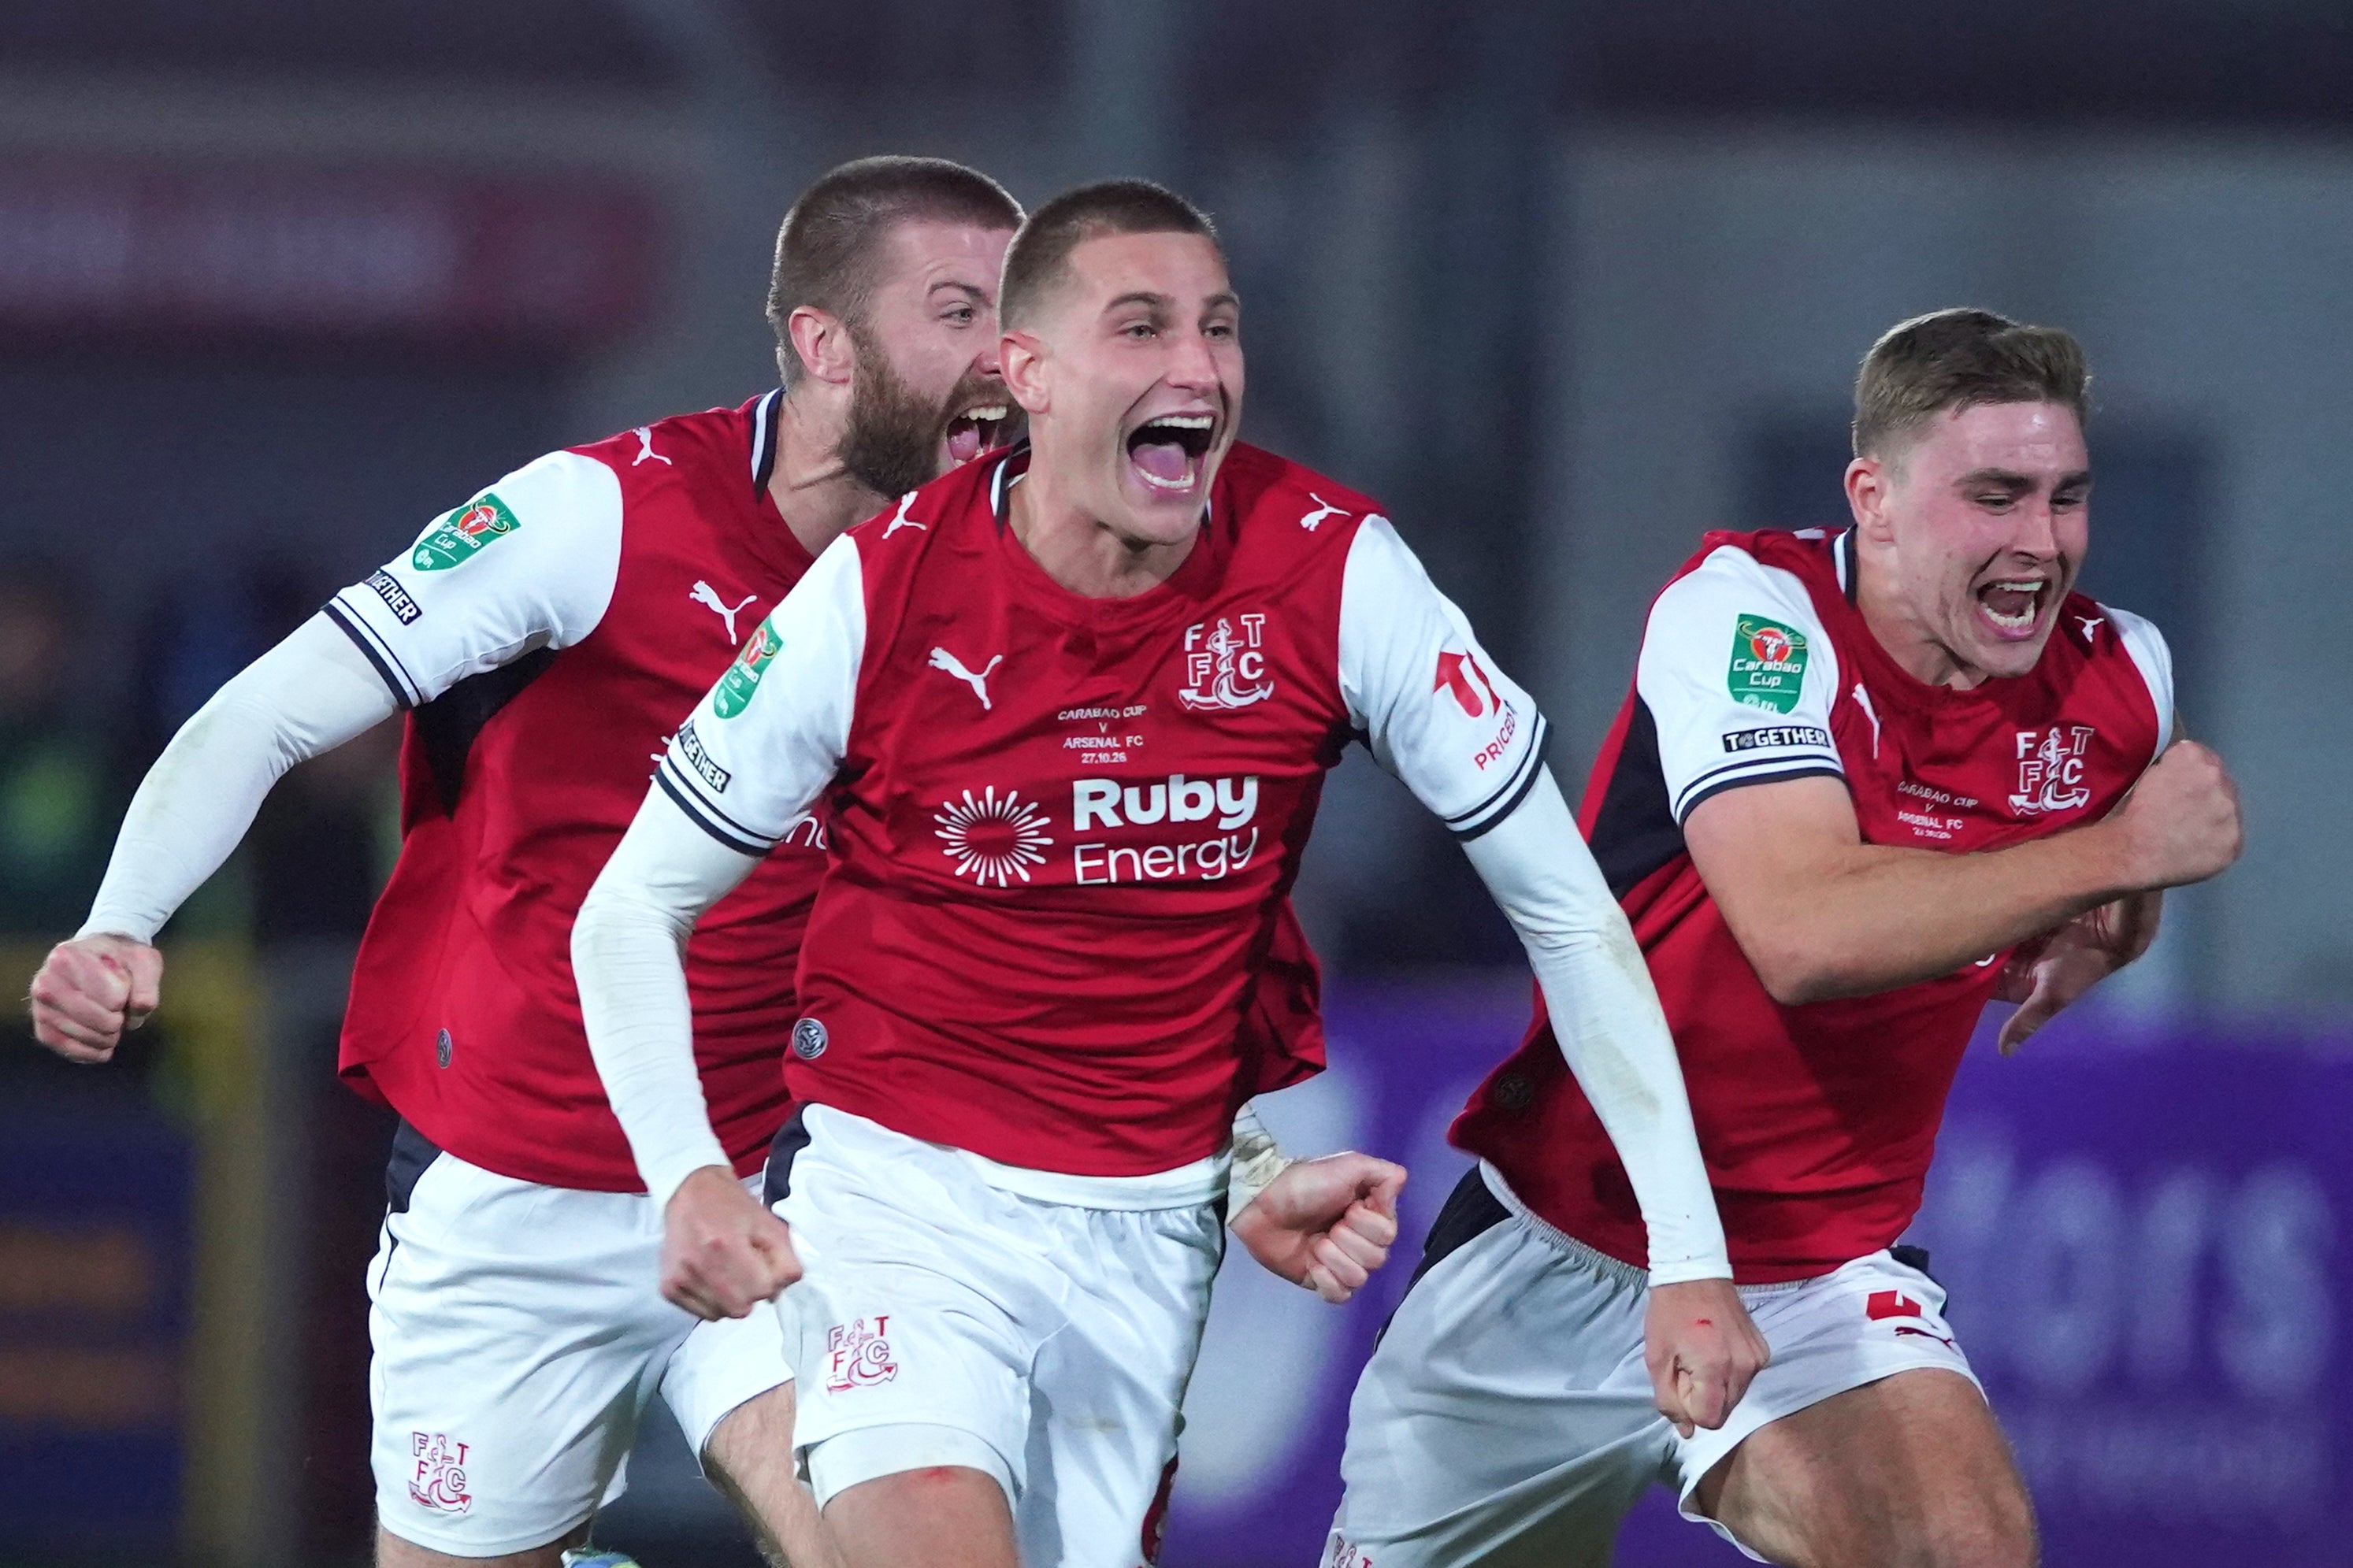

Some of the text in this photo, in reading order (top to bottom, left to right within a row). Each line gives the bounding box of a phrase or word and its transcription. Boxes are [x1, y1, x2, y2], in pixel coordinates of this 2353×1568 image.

[434, 533, 457, 550] Cup
[1733, 658, 1802, 675] Carabao
[1749, 672, 1782, 688] Cup
[1057, 705, 1147, 721] CARABAO CUP
[1063, 735, 1144, 749] ARSENAL FC
[1897, 780, 1950, 803] CARABAO
[1073, 774, 1258, 831] Ruby
[1946, 818, 1963, 829] FC
[1074, 826, 1258, 884] Energy
